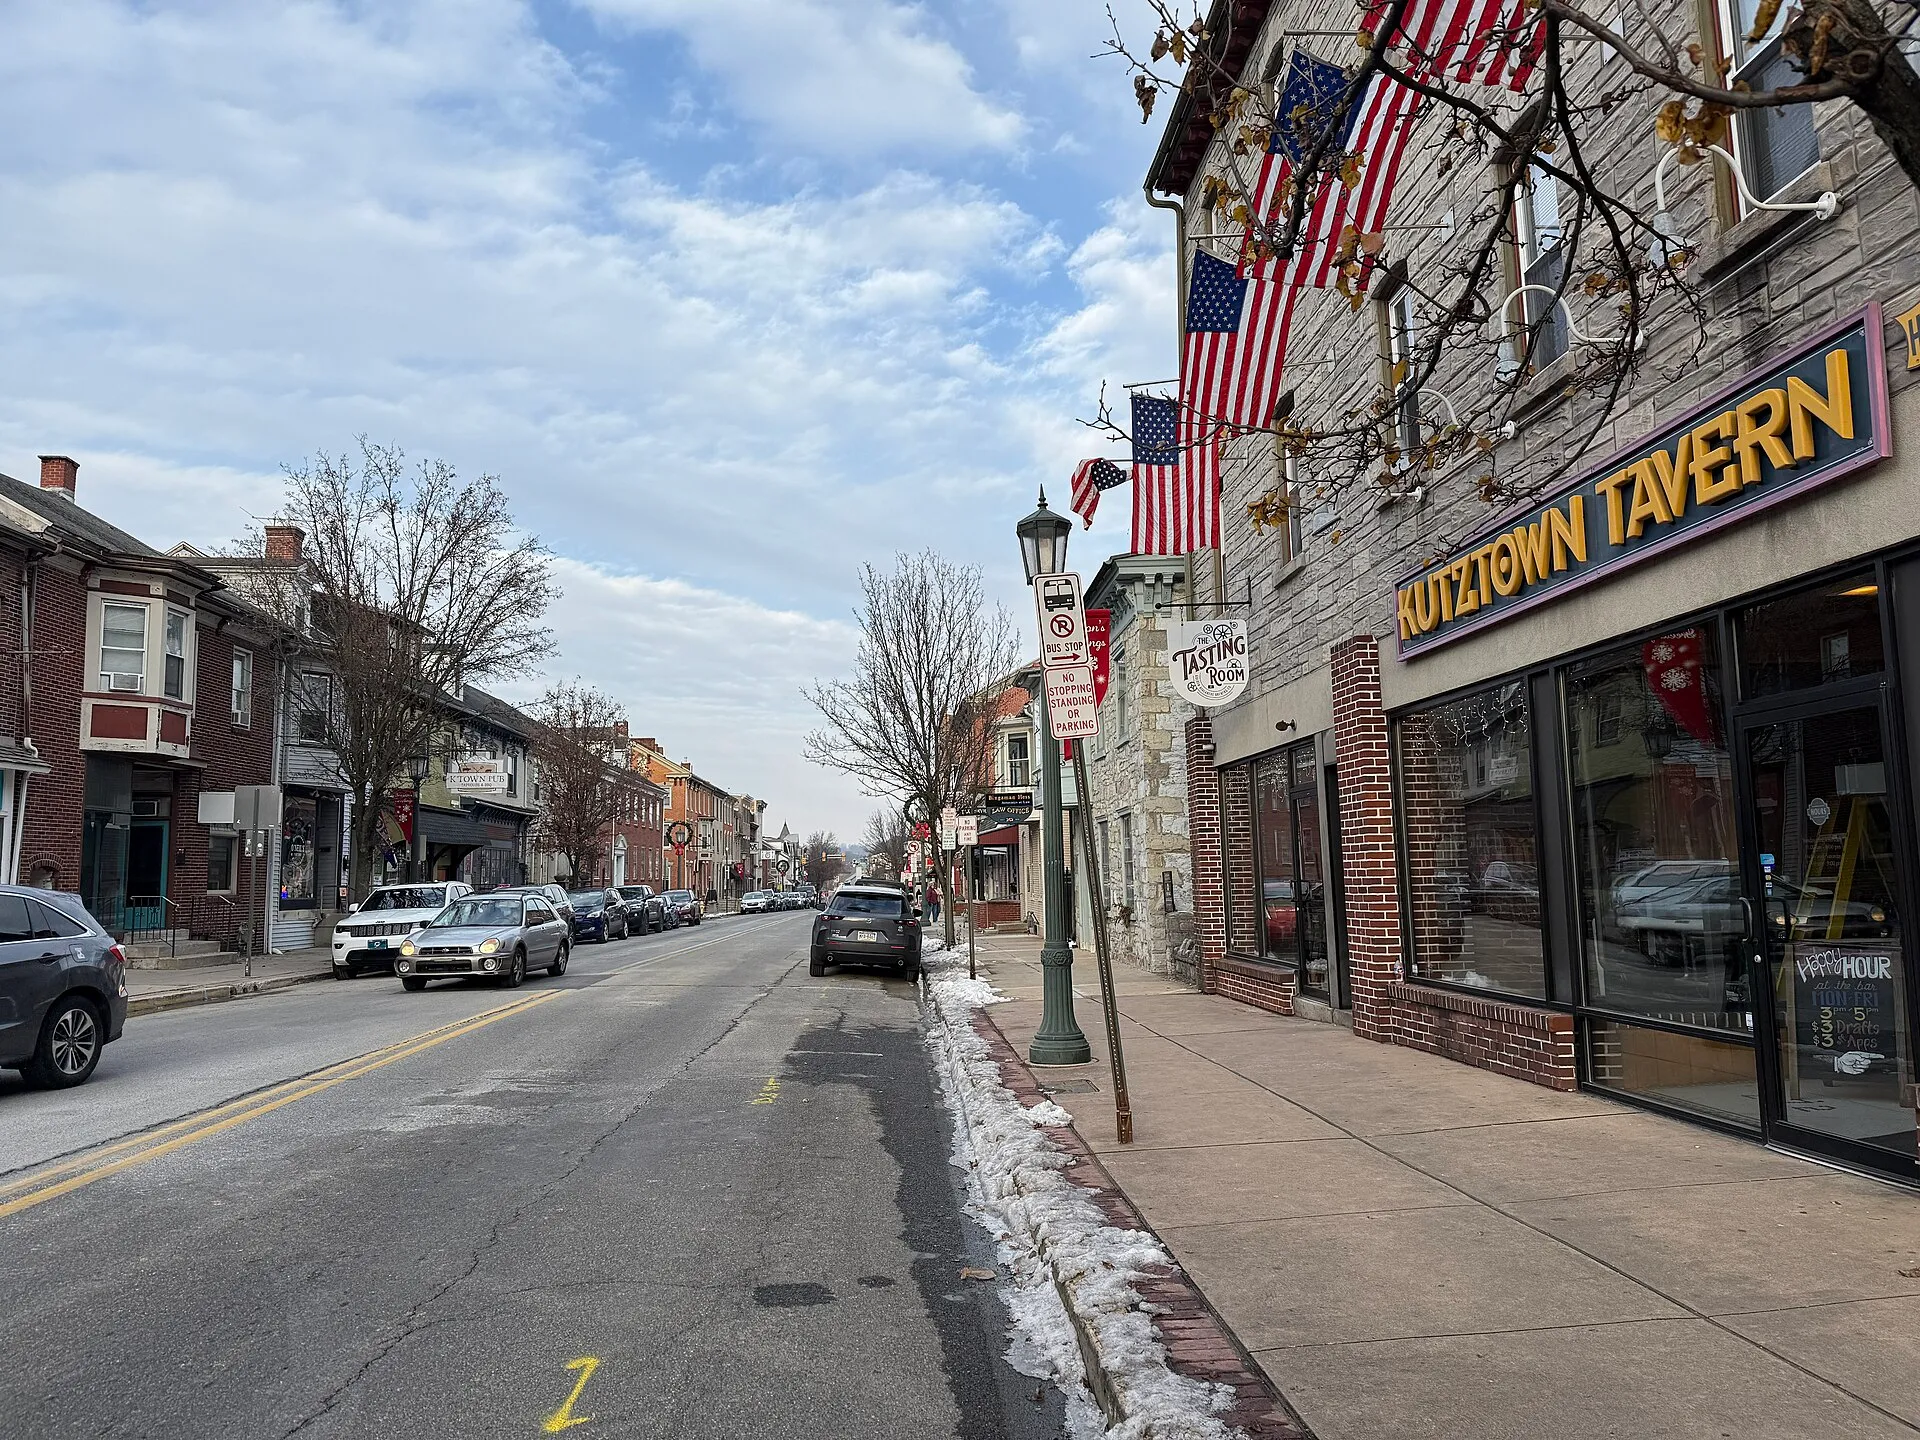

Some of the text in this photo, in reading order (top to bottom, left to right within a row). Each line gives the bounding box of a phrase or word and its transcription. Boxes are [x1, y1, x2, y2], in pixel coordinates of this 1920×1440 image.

[1397, 348, 1854, 641] KUTZTOWN TAVERN
[1046, 643, 1062, 653] BUS
[1064, 641, 1084, 652] STOP
[1197, 637, 1209, 645] THE
[1172, 635, 1246, 681] TASTING
[1062, 673, 1075, 683] NO
[1205, 666, 1245, 687] ROOM
[1049, 683, 1092, 697] STOPPING
[1050, 695, 1094, 708] STANDING
[1067, 708, 1080, 719] OR
[1056, 719, 1094, 732] PARKING
[488, 775, 505, 783] PUB
[1006, 807, 1030, 815] OFFICE
[1810, 807, 1827, 816] HOURS
[1842, 956, 1892, 979] HOUR
[1813, 980, 1878, 990] at the bar
[1836, 1019, 1880, 1035] Drafts
[1847, 1033, 1879, 1051] Apps
